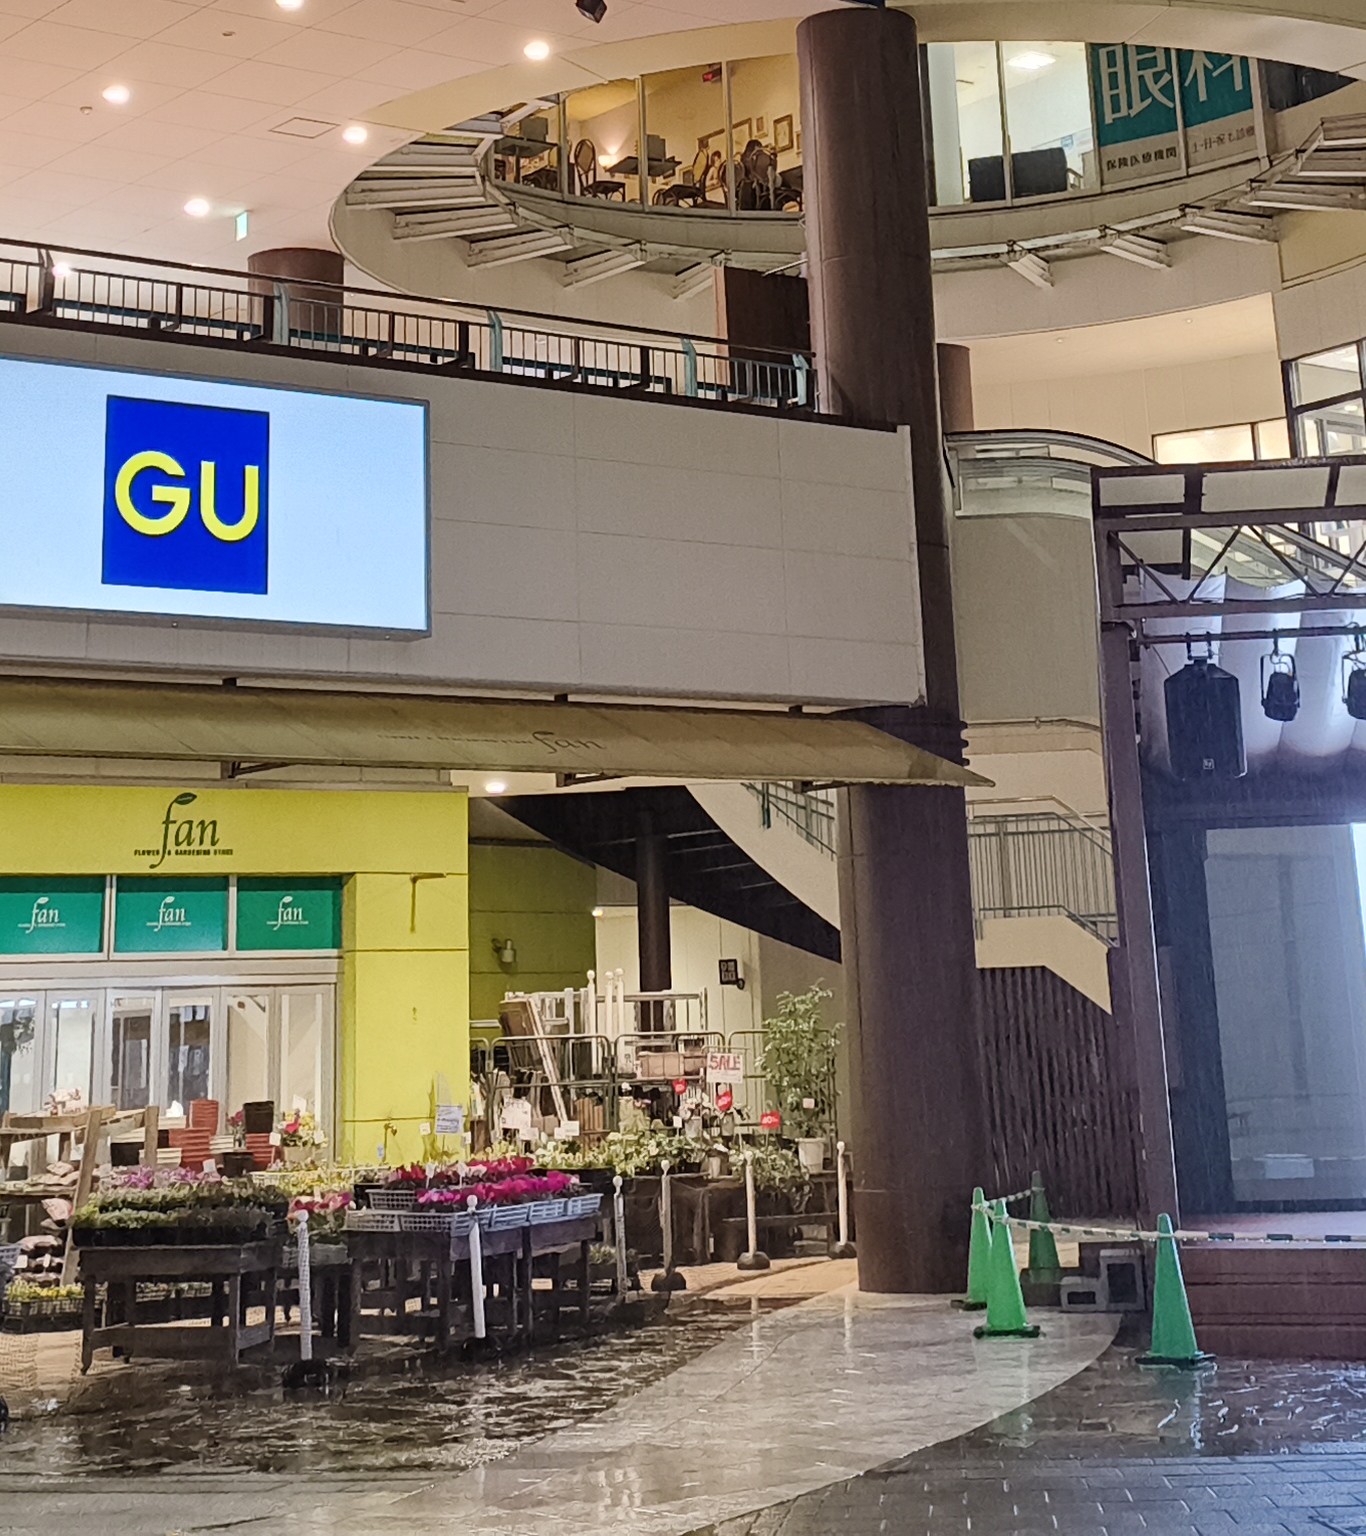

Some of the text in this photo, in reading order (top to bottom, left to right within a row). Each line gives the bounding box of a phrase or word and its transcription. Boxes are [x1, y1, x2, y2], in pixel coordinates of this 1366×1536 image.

[114, 449, 260, 542] GU
[149, 792, 220, 869] fan
[25, 896, 59, 934] fan
[153, 896, 186, 932] fan
[273, 895, 302, 931] fan
[709, 1054, 741, 1071] SALE
